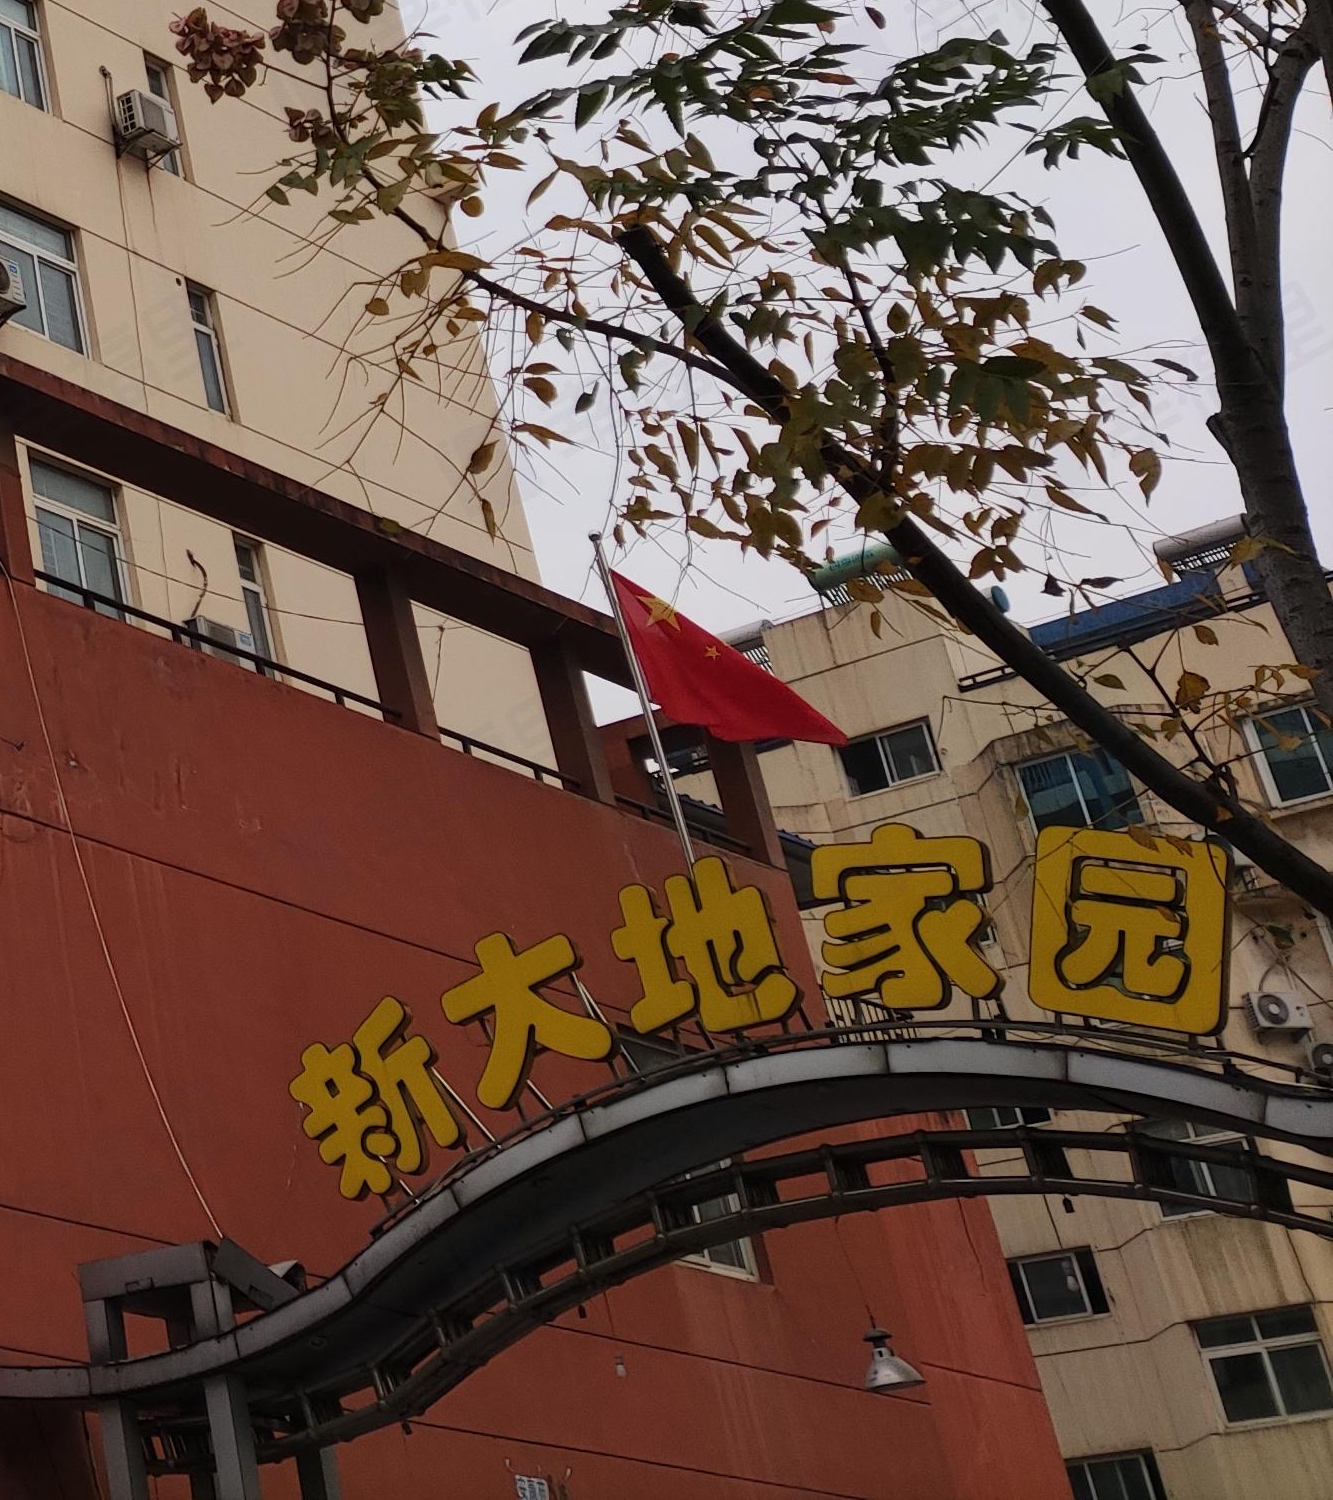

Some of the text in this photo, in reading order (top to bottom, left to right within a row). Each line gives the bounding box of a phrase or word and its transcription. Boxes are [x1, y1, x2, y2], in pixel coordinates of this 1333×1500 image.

[289, 822, 1231, 1199] 新大地家园
